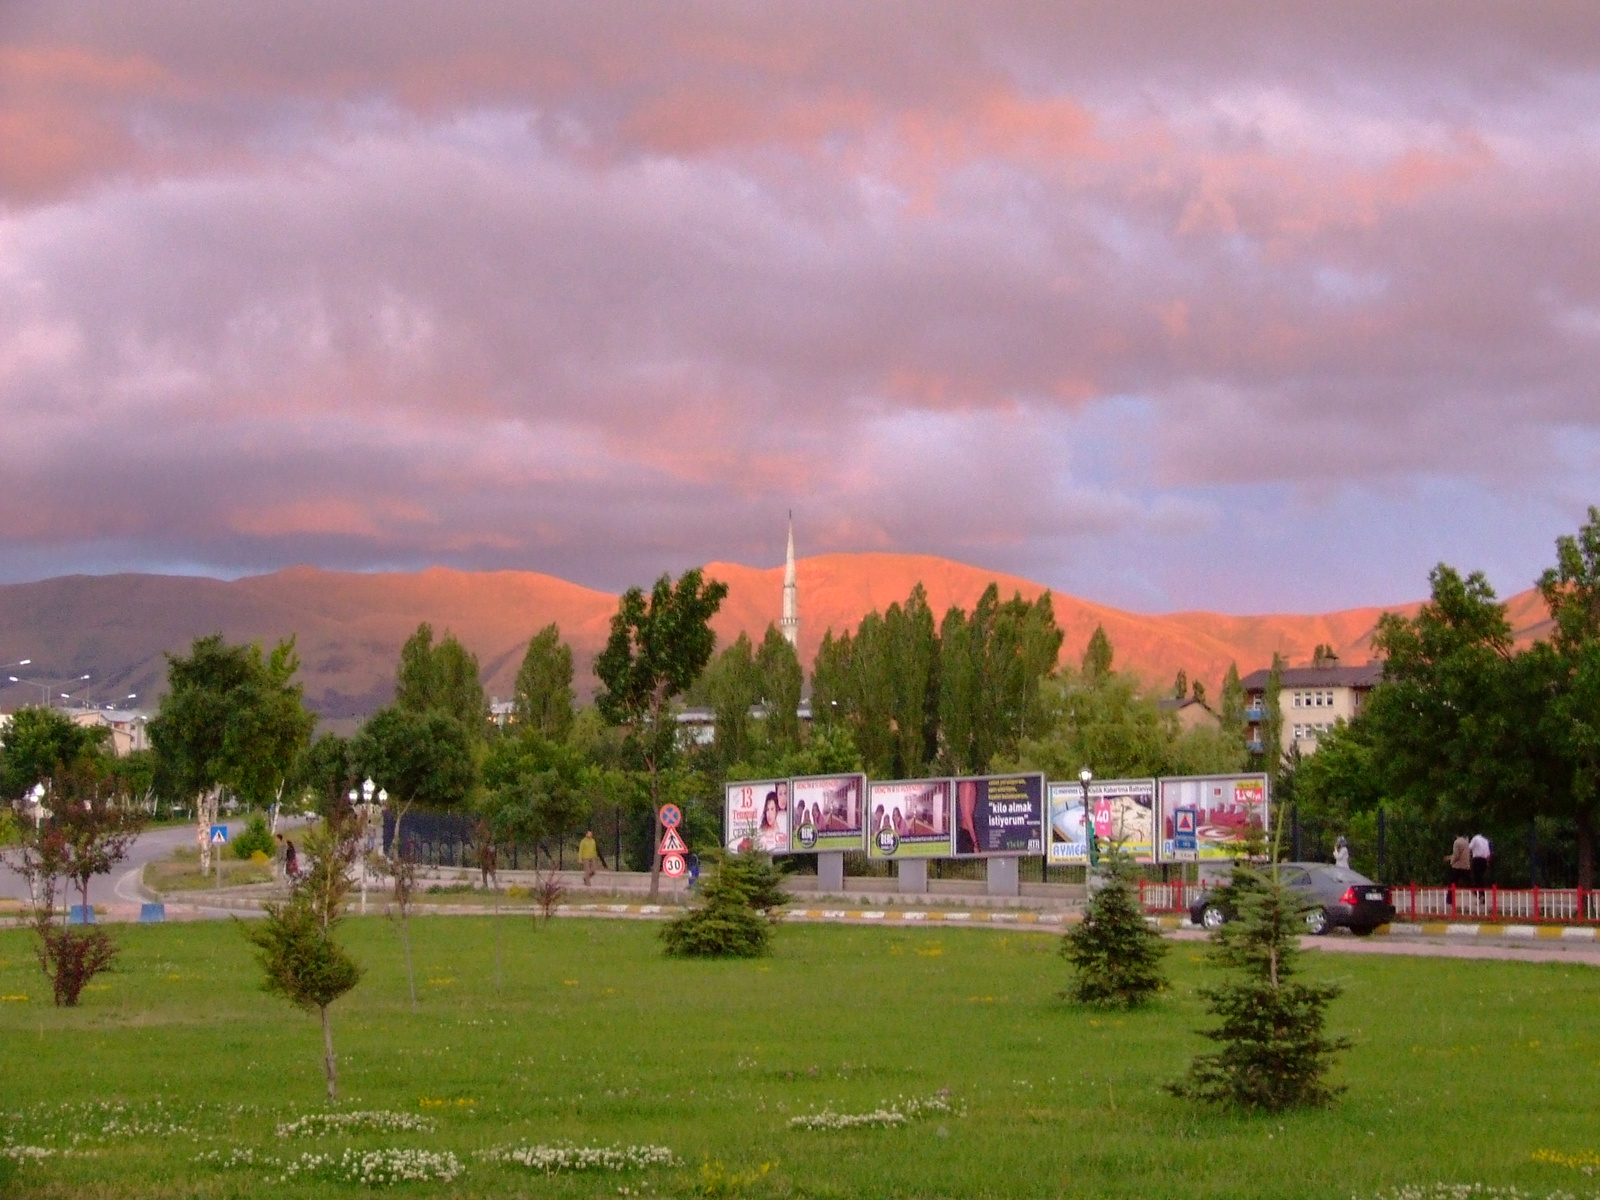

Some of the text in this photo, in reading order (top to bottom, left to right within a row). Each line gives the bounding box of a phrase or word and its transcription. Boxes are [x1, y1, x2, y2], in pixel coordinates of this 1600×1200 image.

[741, 787, 753, 808] 13
[989, 801, 1032, 813] "kilo almak
[1096, 810, 1109, 823] 40
[667, 859, 681, 871] 30
